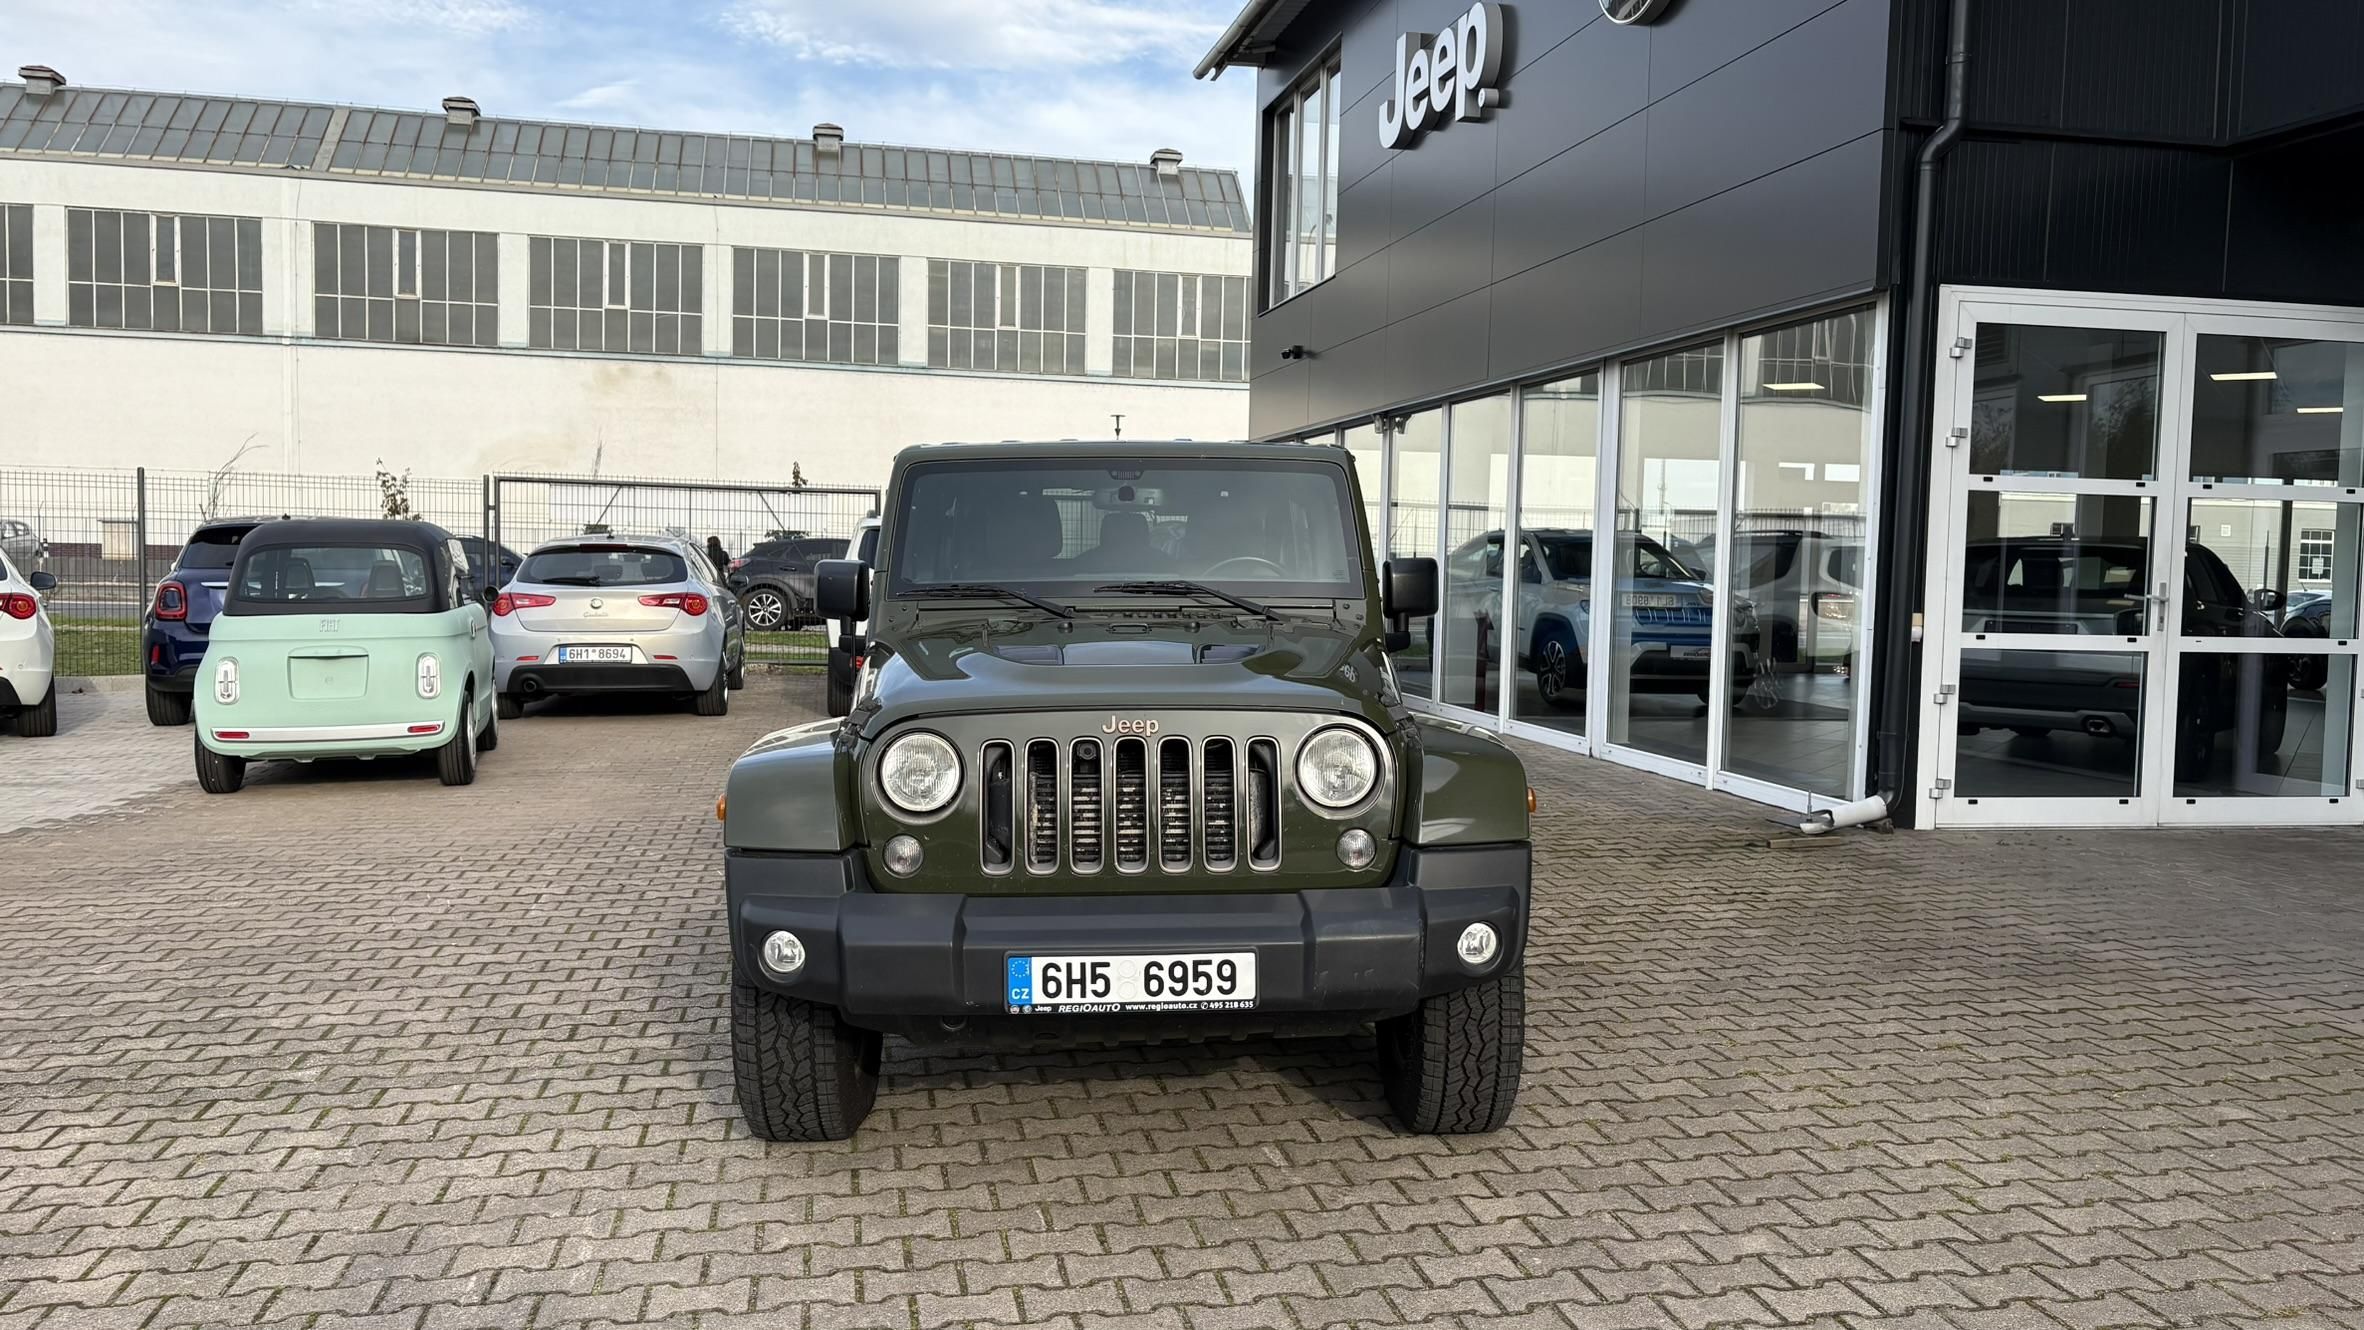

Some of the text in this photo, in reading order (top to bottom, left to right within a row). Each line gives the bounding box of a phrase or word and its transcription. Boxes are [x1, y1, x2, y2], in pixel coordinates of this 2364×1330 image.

[1379, 2, 1487, 149] Jeep
[569, 648, 626, 659] 6H1 8694
[1102, 715, 1159, 737] Jeep
[1042, 959, 1237, 999] 6H5 6959
[1011, 988, 1030, 999] CZ
[1034, 1004, 1052, 1013] Jeep
[1058, 1002, 1121, 1013] REGIOAUTO
[1125, 1001, 1199, 1012] www.regioauto.cz
